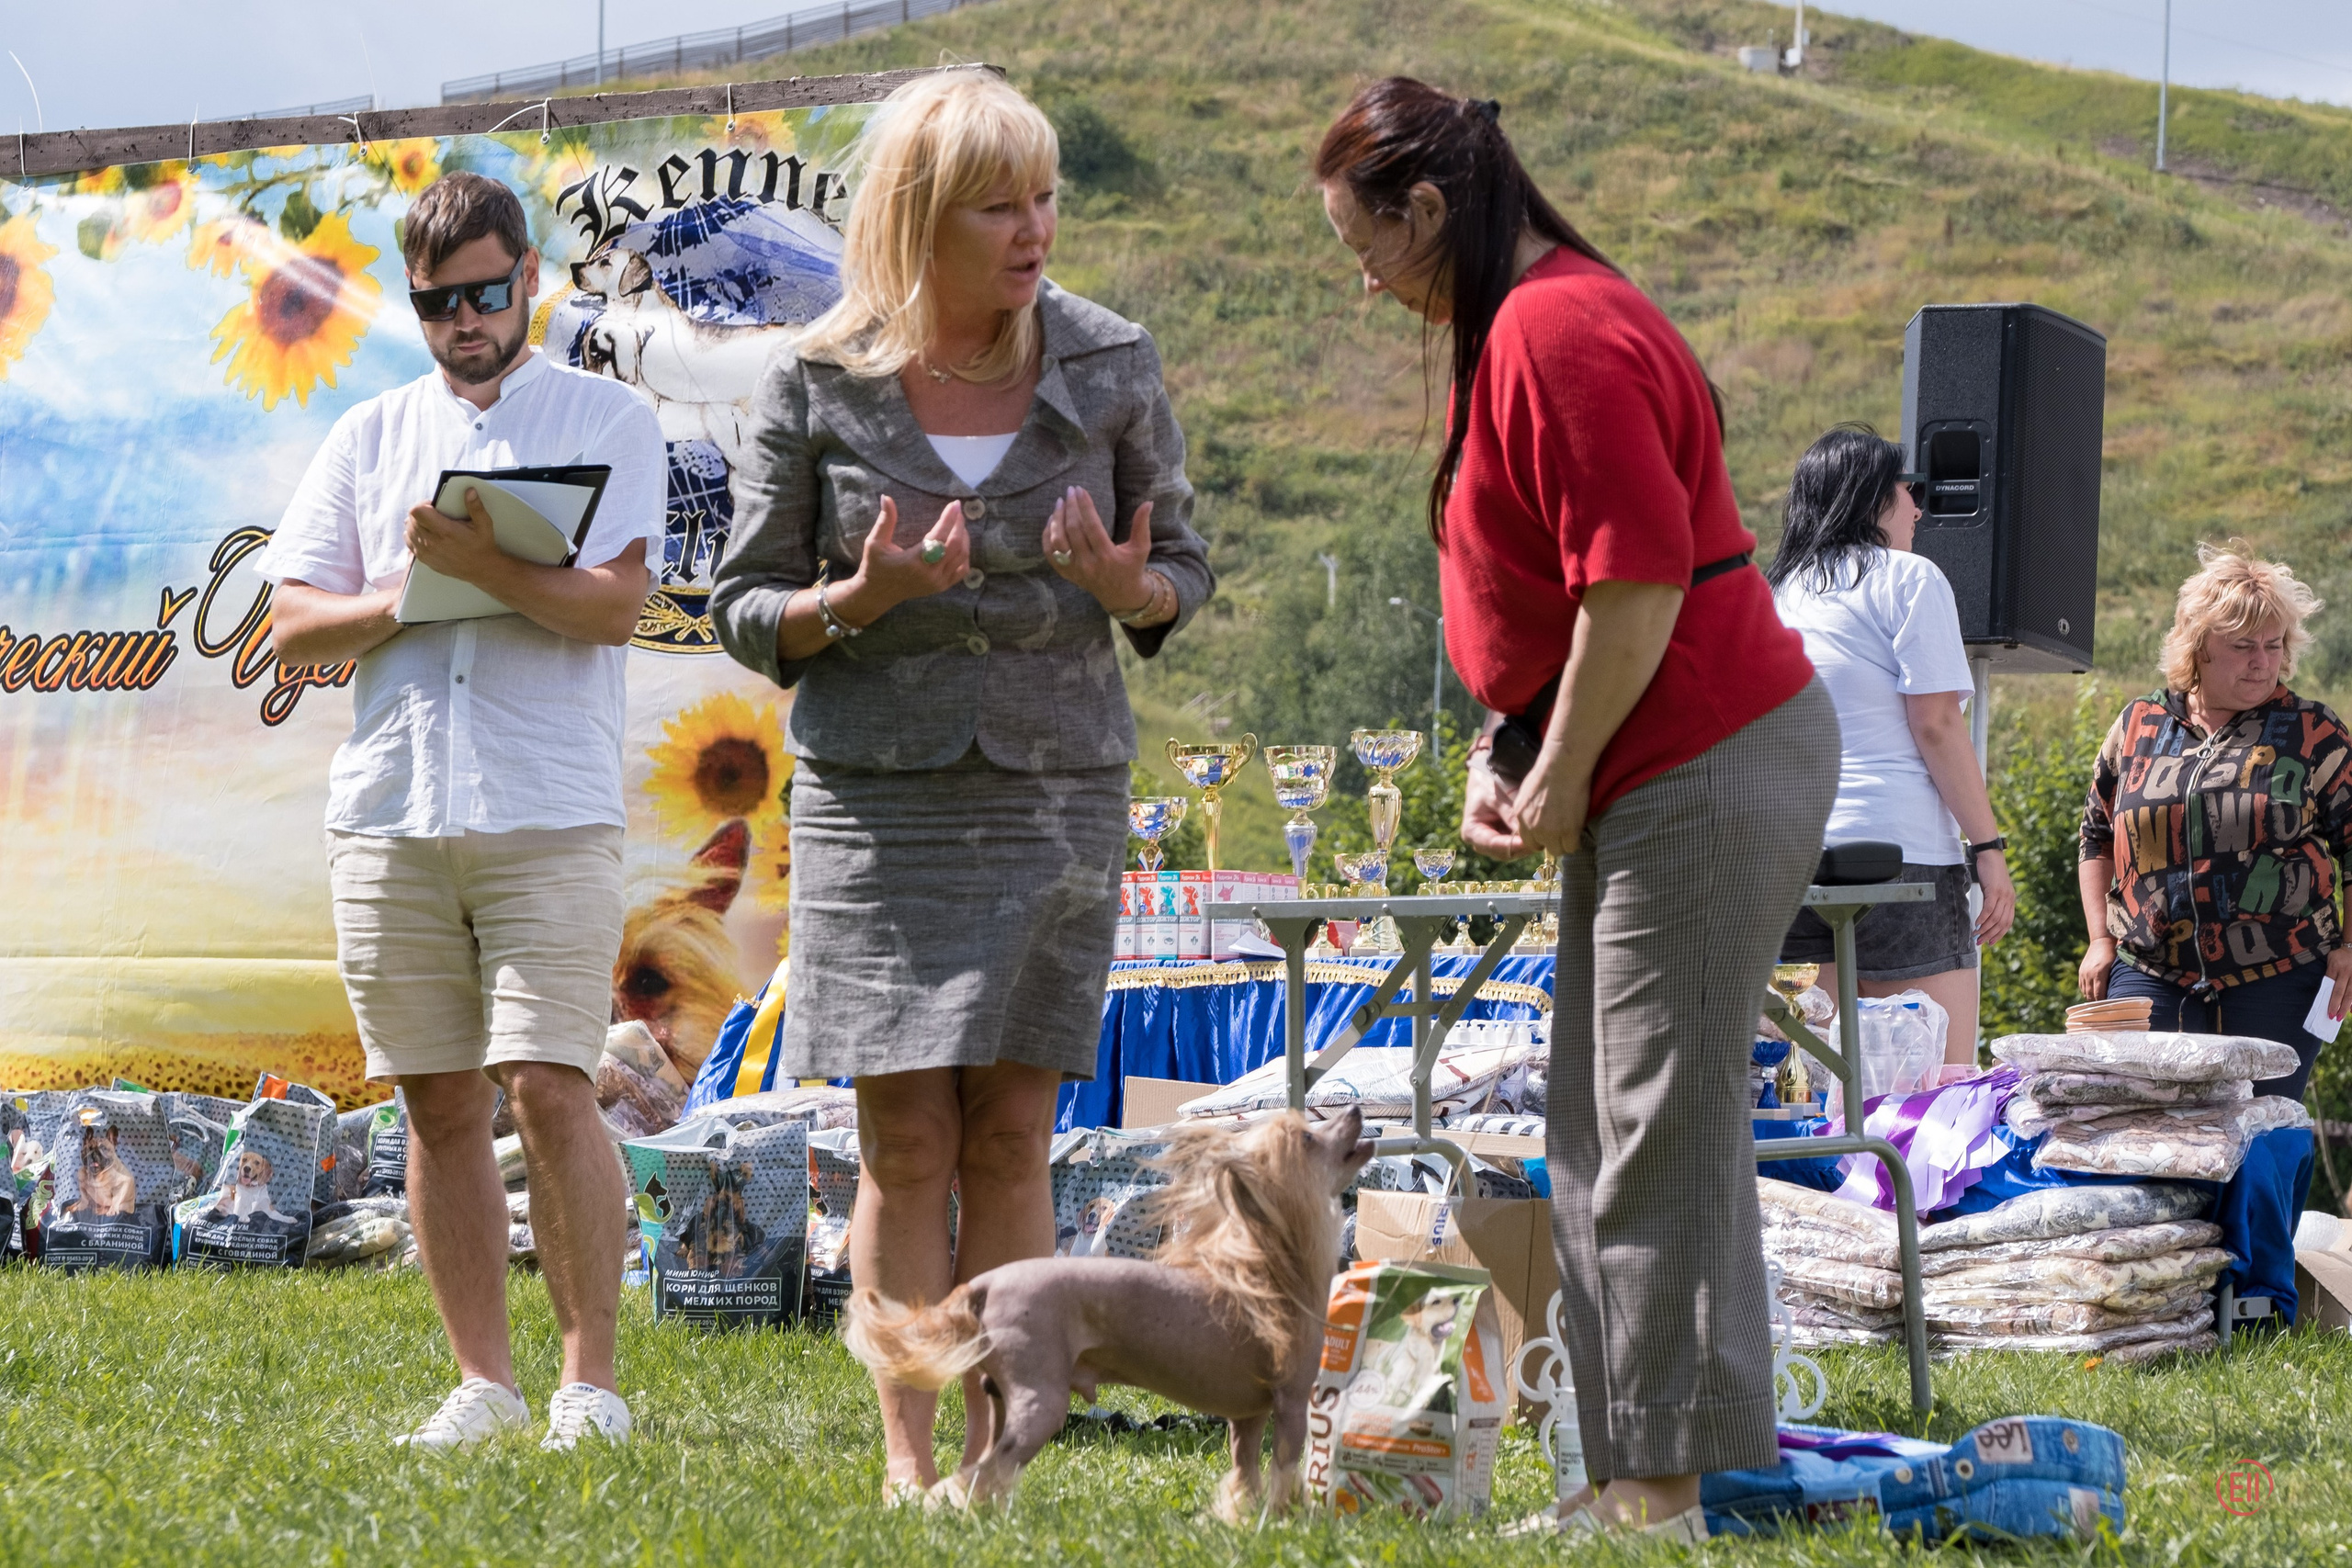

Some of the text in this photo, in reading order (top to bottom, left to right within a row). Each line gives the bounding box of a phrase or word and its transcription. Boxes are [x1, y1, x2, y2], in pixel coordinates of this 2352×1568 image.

[556, 148, 848, 258] Kenne
[123, 1227, 144, 1235] СОБАК
[88, 1240, 144, 1250] БАРАНИНОЙ
[224, 1249, 278, 1260] ГОВЯДИНОЙ
[665, 1269, 719, 1279] МИНИ ЮНИОР
[666, 1282, 777, 1294] КОРМ ДЛЯ ЩЕНКОВ
[820, 1287, 832, 1295] ДЛЯ
[684, 1295, 778, 1306] МЕЛКИХ ПОРОД
[1324, 1336, 1351, 1350] ADULT
[1307, 1385, 1340, 1499] RIUS
[1977, 1424, 2029, 1454] Lee
